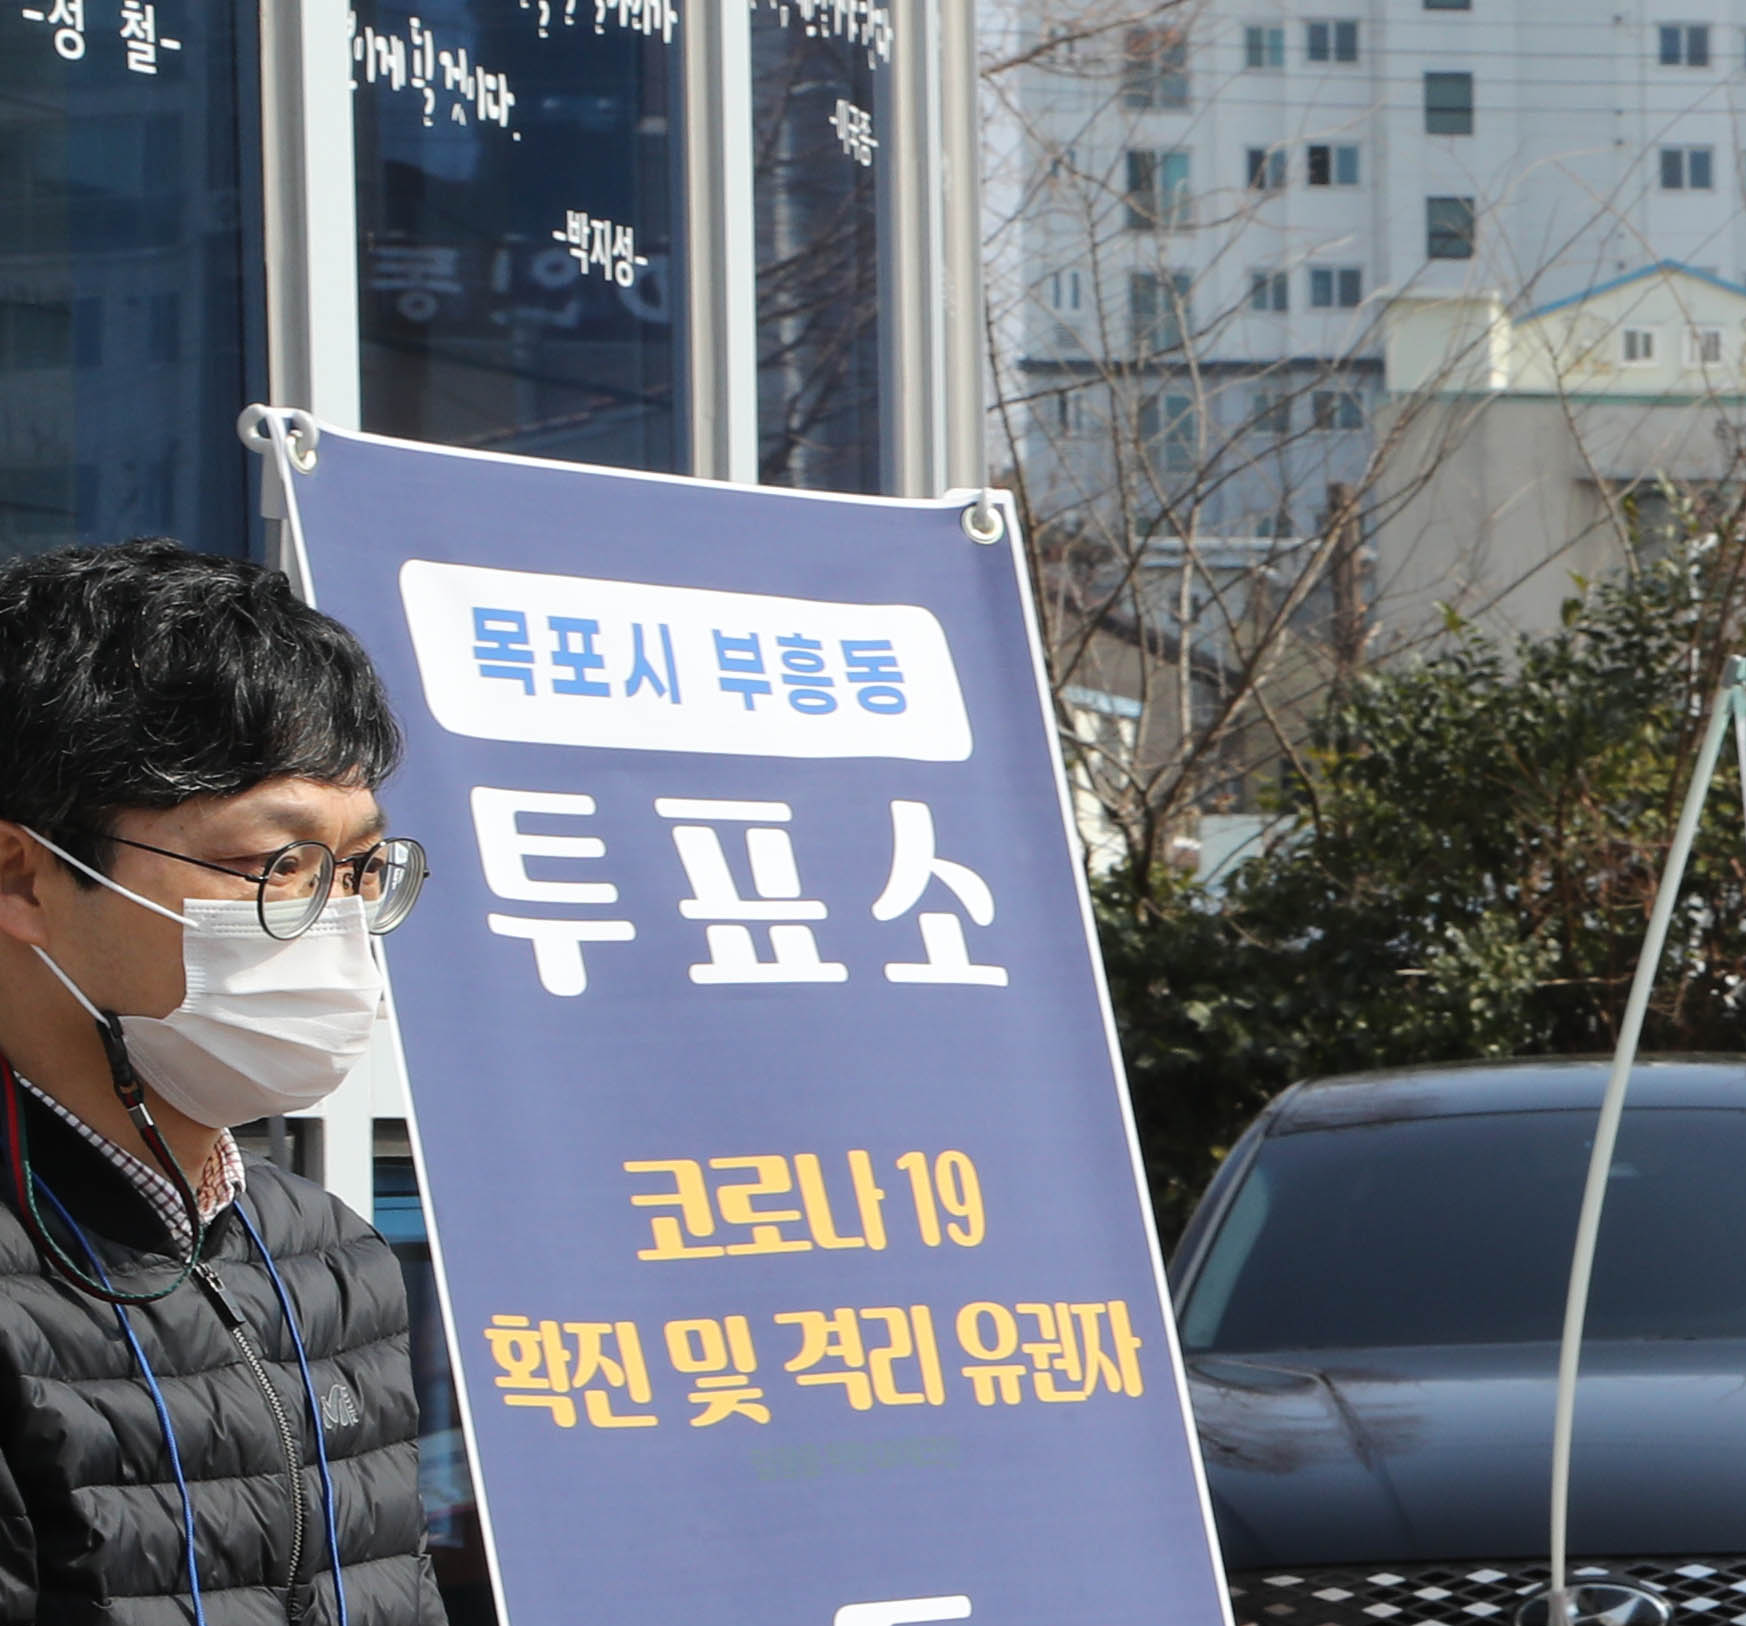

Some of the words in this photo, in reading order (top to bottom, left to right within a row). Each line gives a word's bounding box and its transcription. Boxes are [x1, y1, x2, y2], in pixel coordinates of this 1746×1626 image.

[552, 209, 649, 288] -박지성-
[471, 606, 683, 705] 목포시
[711, 628, 908, 716] 부흥동
[470, 785, 1009, 996] 투표소
[623, 1149, 887, 1261] 코로나
[895, 1149, 986, 1248] 19
[484, 1314, 660, 1429] 확진
[664, 1315, 772, 1428] 및
[774, 1304, 946, 1411] 격리
[954, 1300, 1145, 1407] 유권자
